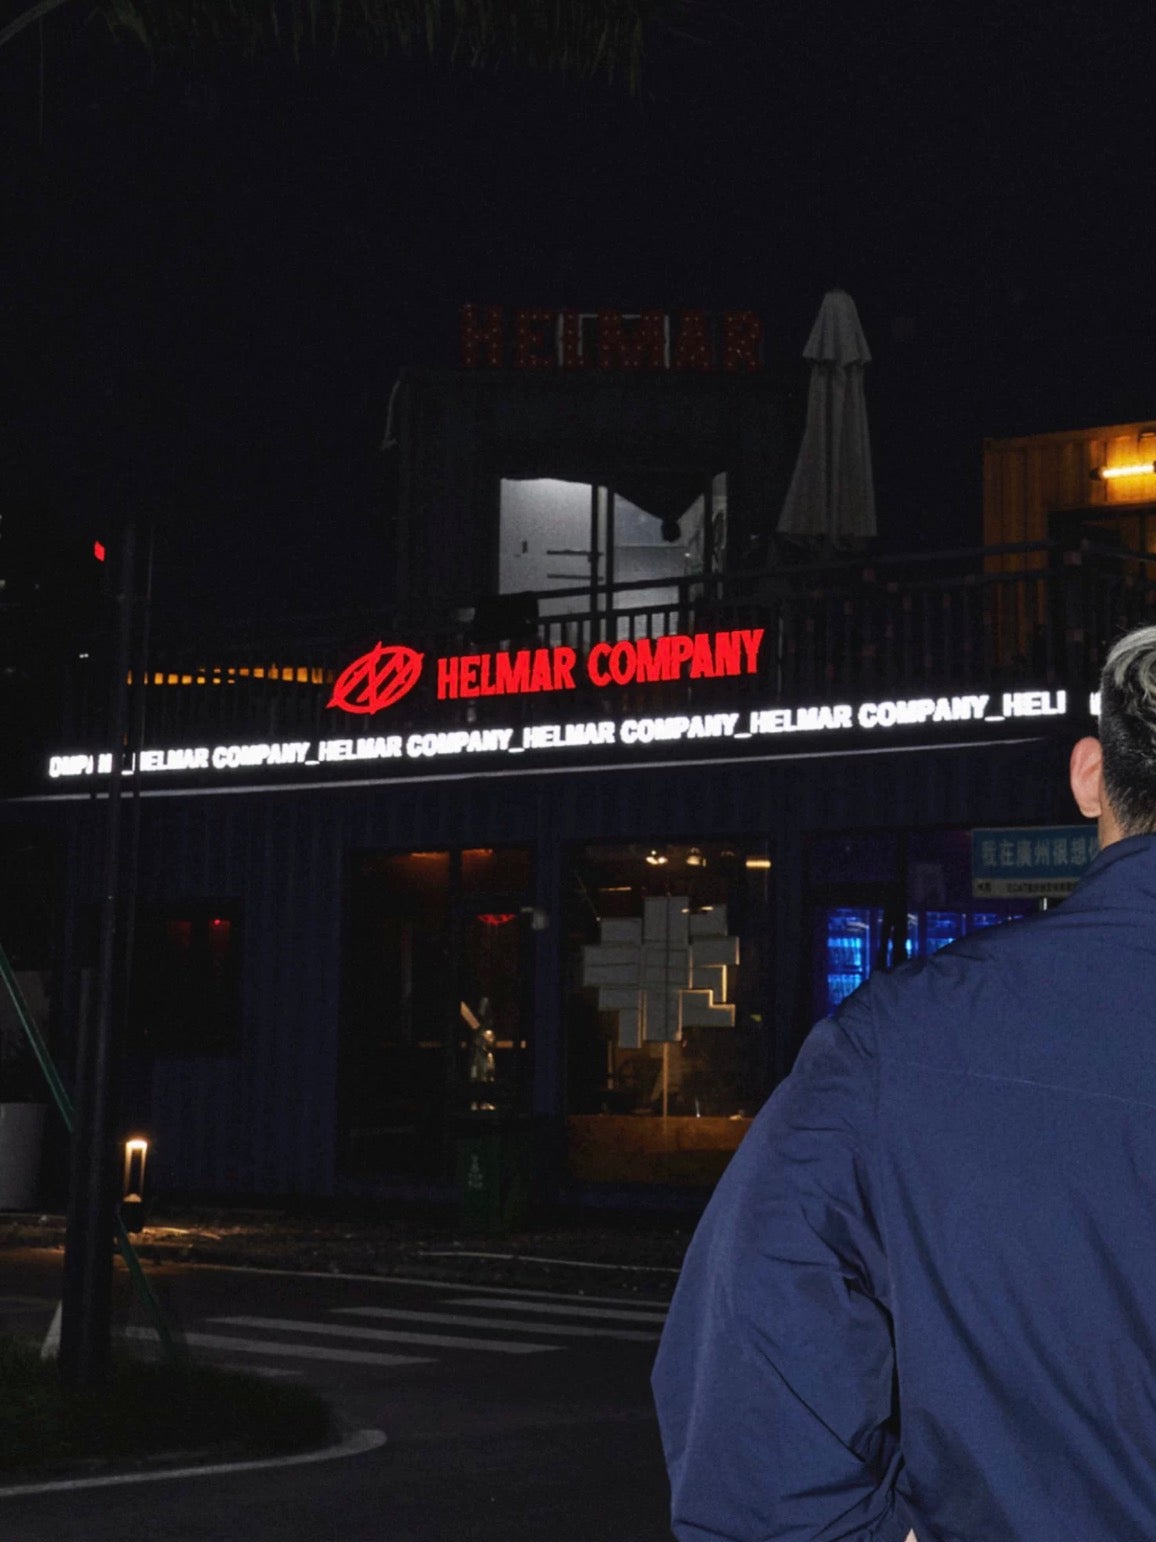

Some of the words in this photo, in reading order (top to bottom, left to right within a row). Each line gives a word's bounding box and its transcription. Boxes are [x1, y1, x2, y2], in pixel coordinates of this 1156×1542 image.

[460, 304, 763, 370] HELMAR
[437, 647, 575, 700] HELMAR
[588, 629, 764, 687] COMPANY
